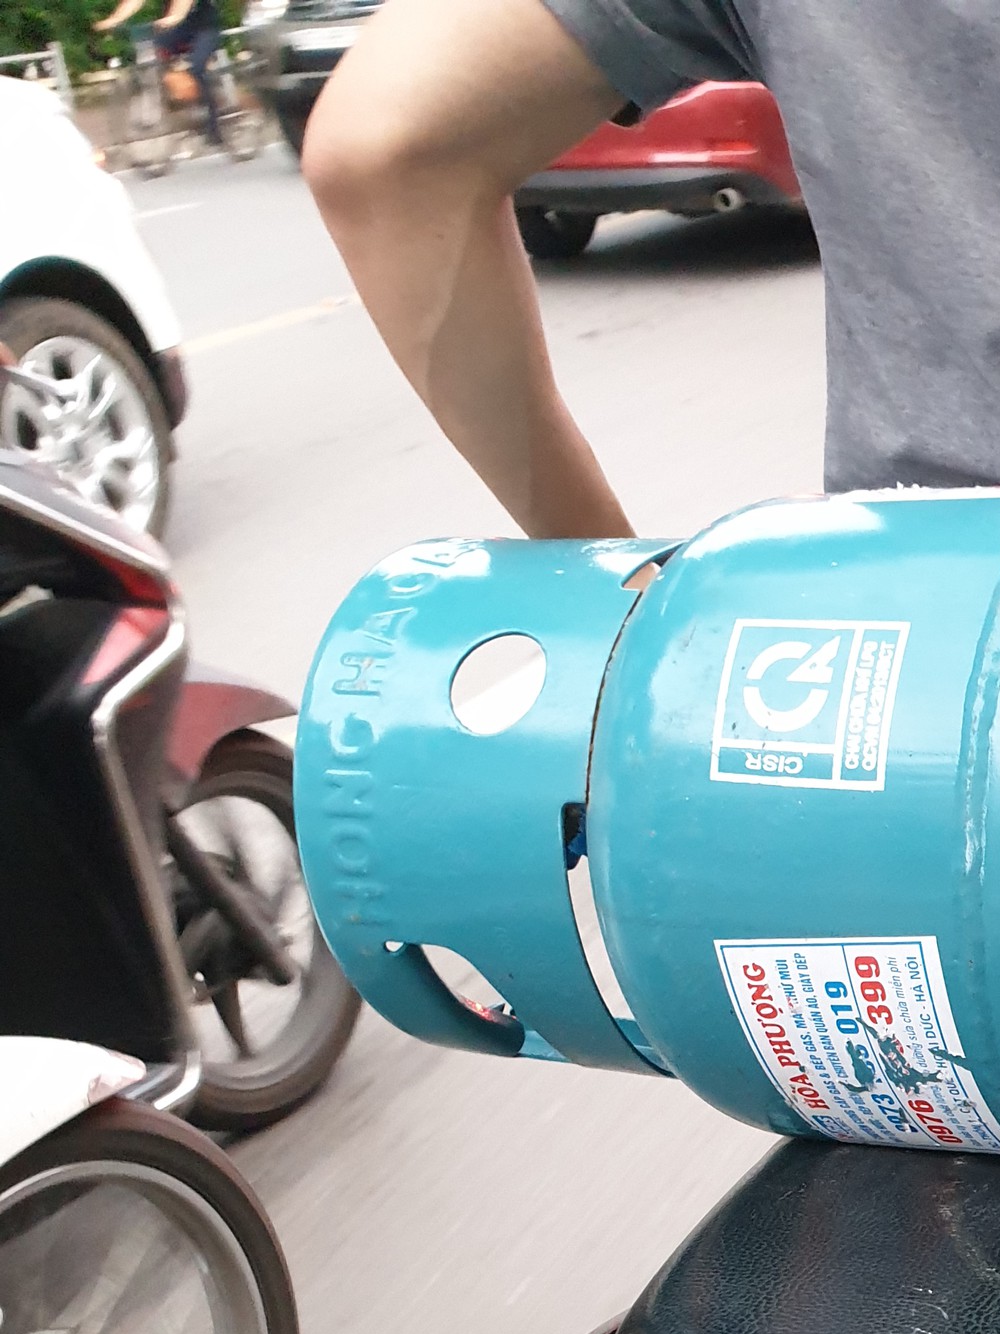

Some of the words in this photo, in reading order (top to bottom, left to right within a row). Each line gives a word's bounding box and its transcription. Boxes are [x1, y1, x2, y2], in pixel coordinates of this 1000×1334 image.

[904, 956, 921, 979] NỘI
[824, 981, 859, 1034] 019
[854, 956, 893, 1025] 399
[910, 984, 926, 1002] HÀ
[742, 963, 801, 1068] PHƯỢNG
[823, 1081, 841, 1095] GAS
[908, 1100, 963, 1143] 0976
